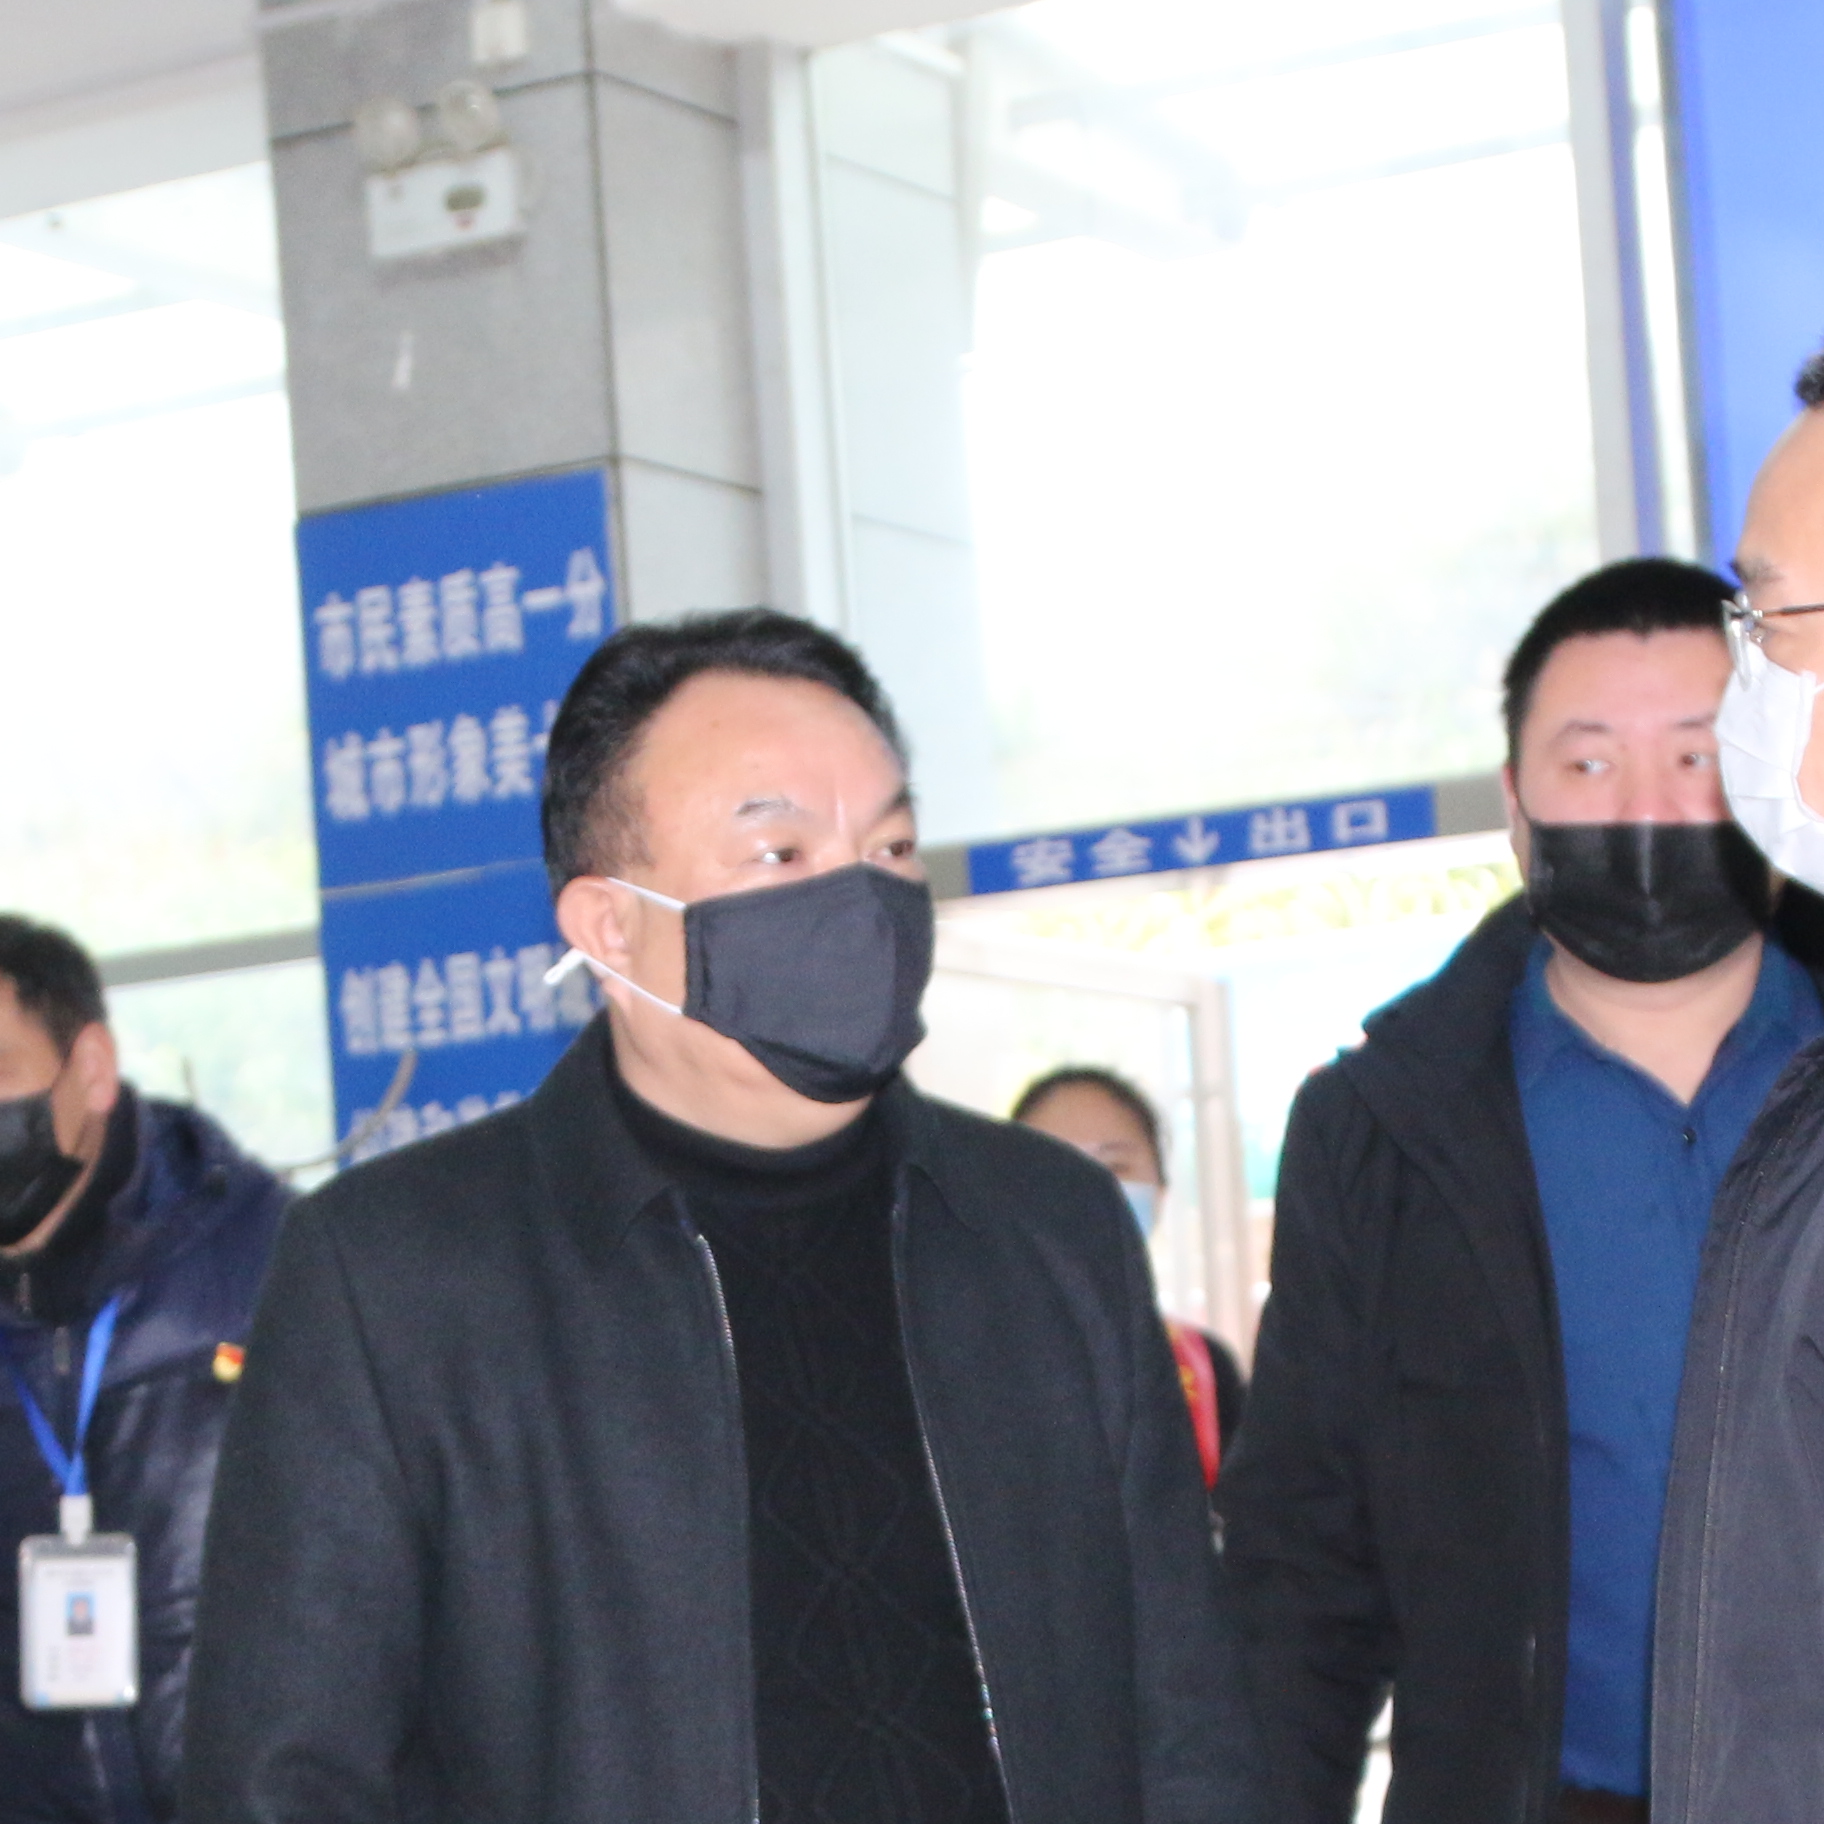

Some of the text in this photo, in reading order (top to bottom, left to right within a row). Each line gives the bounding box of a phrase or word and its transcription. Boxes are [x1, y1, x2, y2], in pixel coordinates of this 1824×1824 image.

[314, 546, 606, 682] 市民素质高一分
[324, 699, 559, 821] 城市形象美
[1010, 798, 1390, 887] 安全出口
[340, 945, 601, 1055] 创建全国文明城
